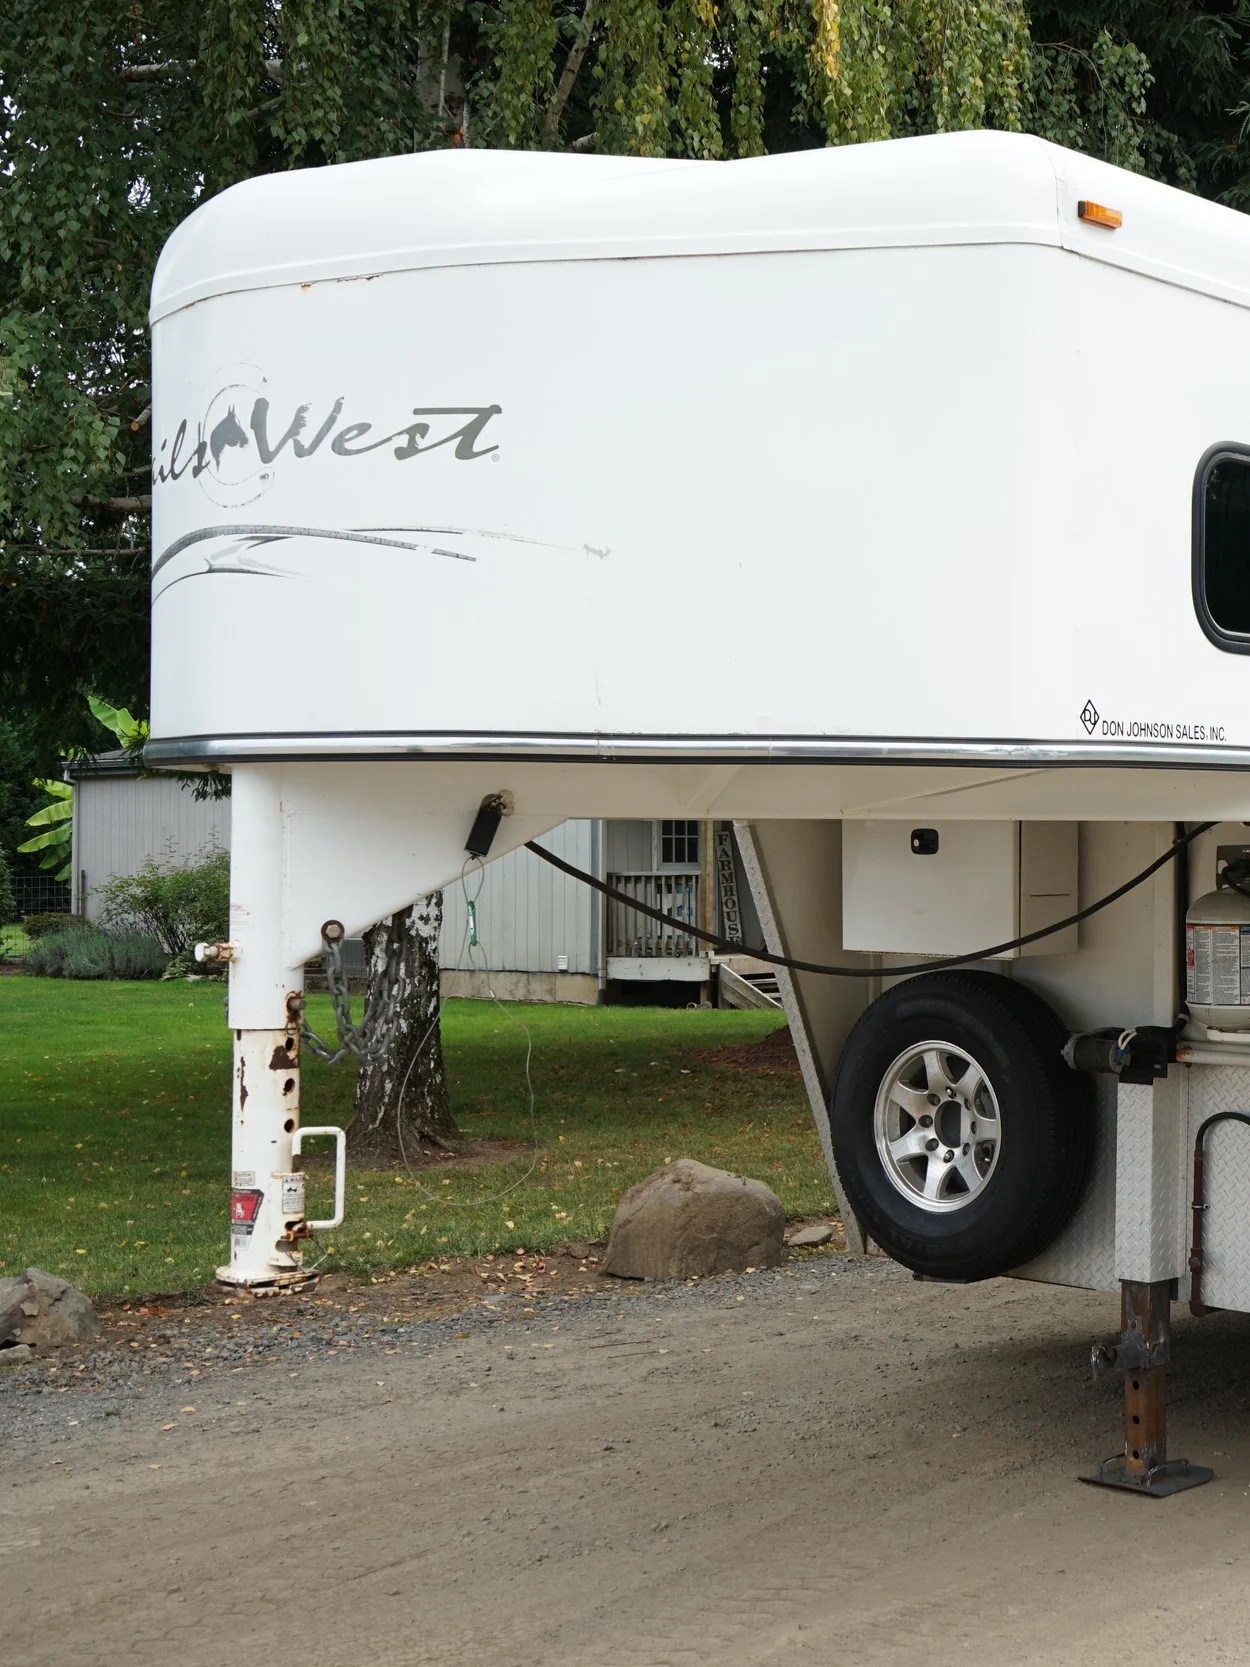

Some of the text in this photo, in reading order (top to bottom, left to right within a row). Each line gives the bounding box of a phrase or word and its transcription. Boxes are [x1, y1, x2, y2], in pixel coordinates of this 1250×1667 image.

[250, 396, 503, 464] West
[1102, 720, 1227, 742] DON JOHNSON SALES, INC.
